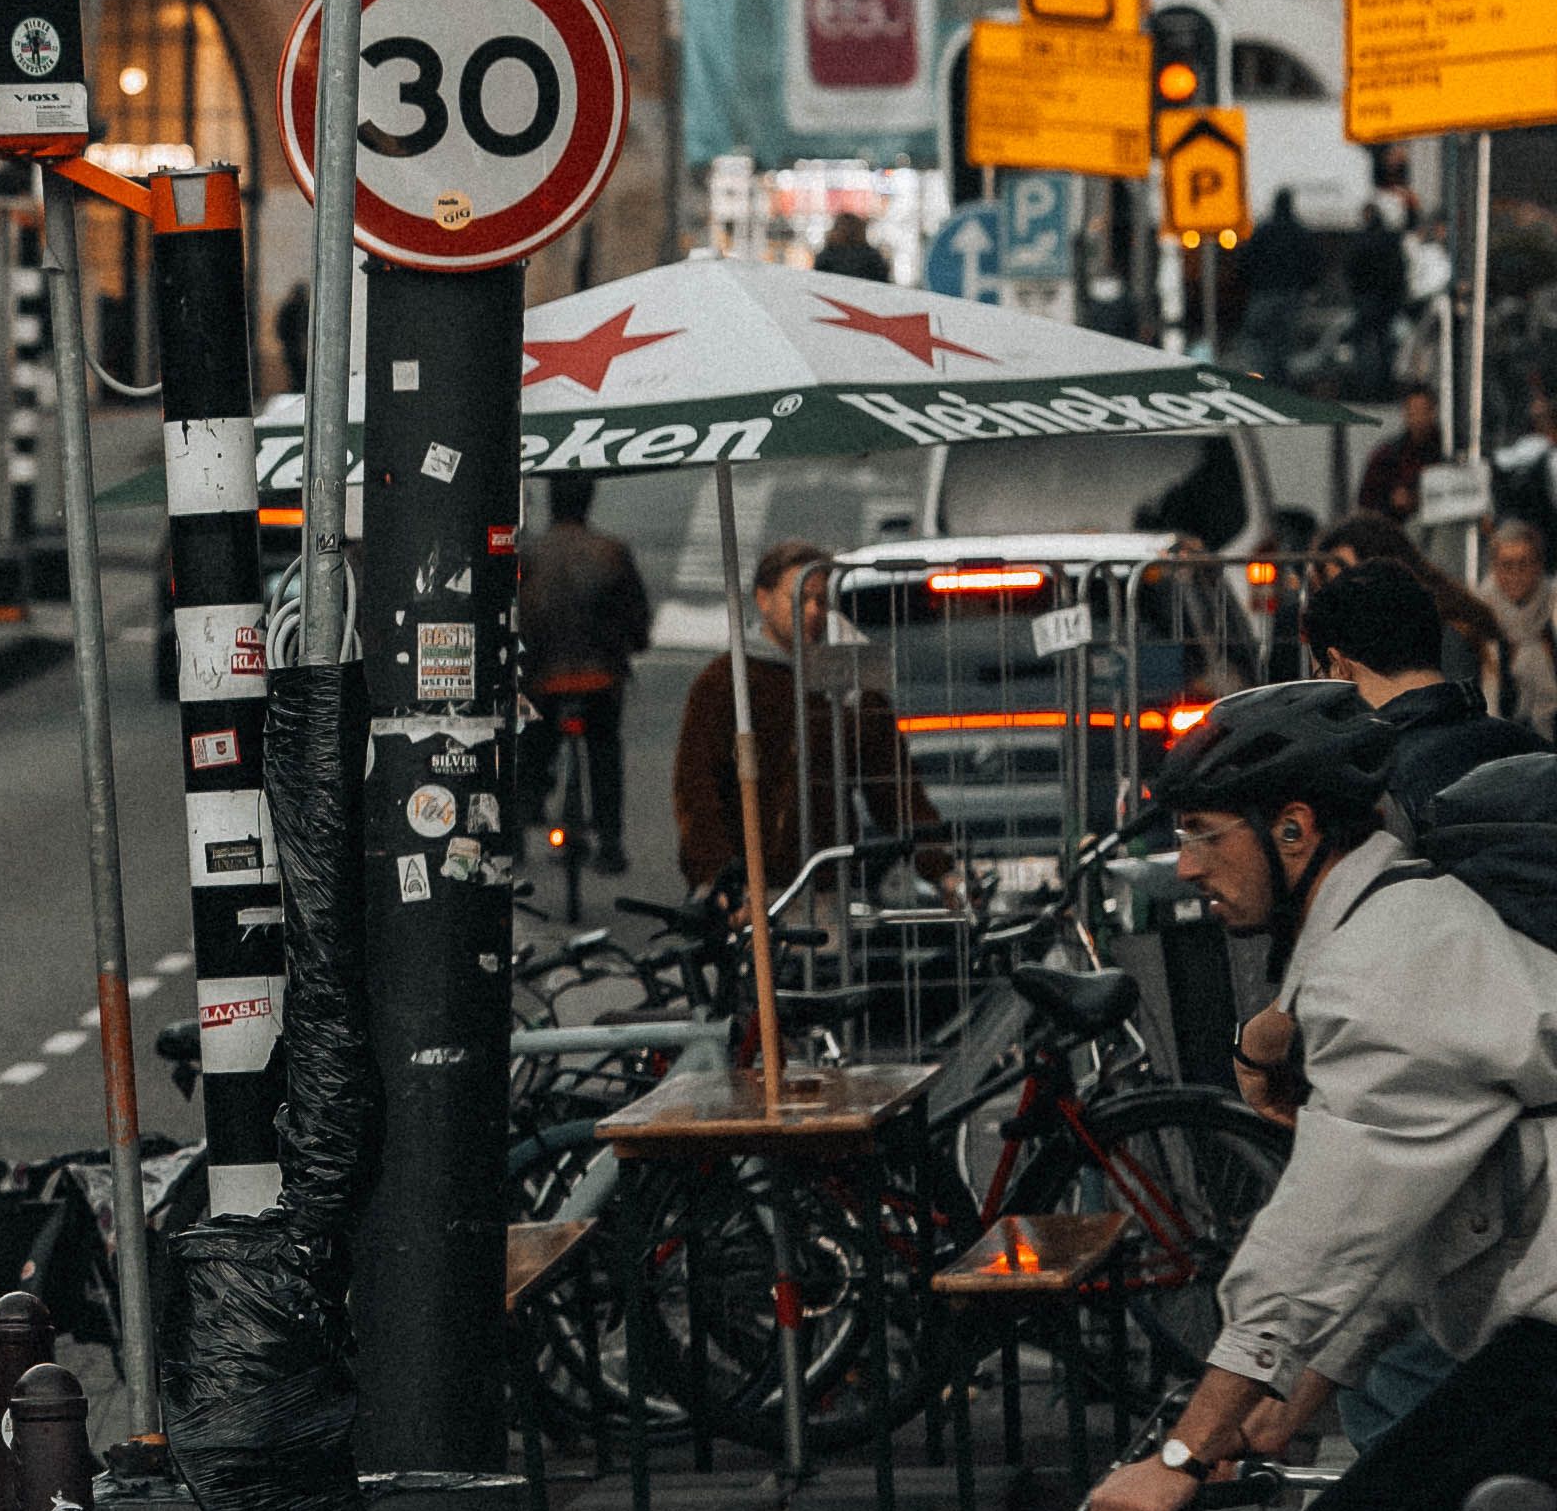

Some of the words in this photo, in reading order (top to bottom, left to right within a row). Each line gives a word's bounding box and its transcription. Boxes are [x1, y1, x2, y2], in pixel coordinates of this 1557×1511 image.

[356, 34, 561, 158] 30
[1015, 179, 1056, 236] P
[1189, 168, 1222, 209] P
[838, 384, 1301, 446] Heineken
[431, 754, 477, 768] SILVER
